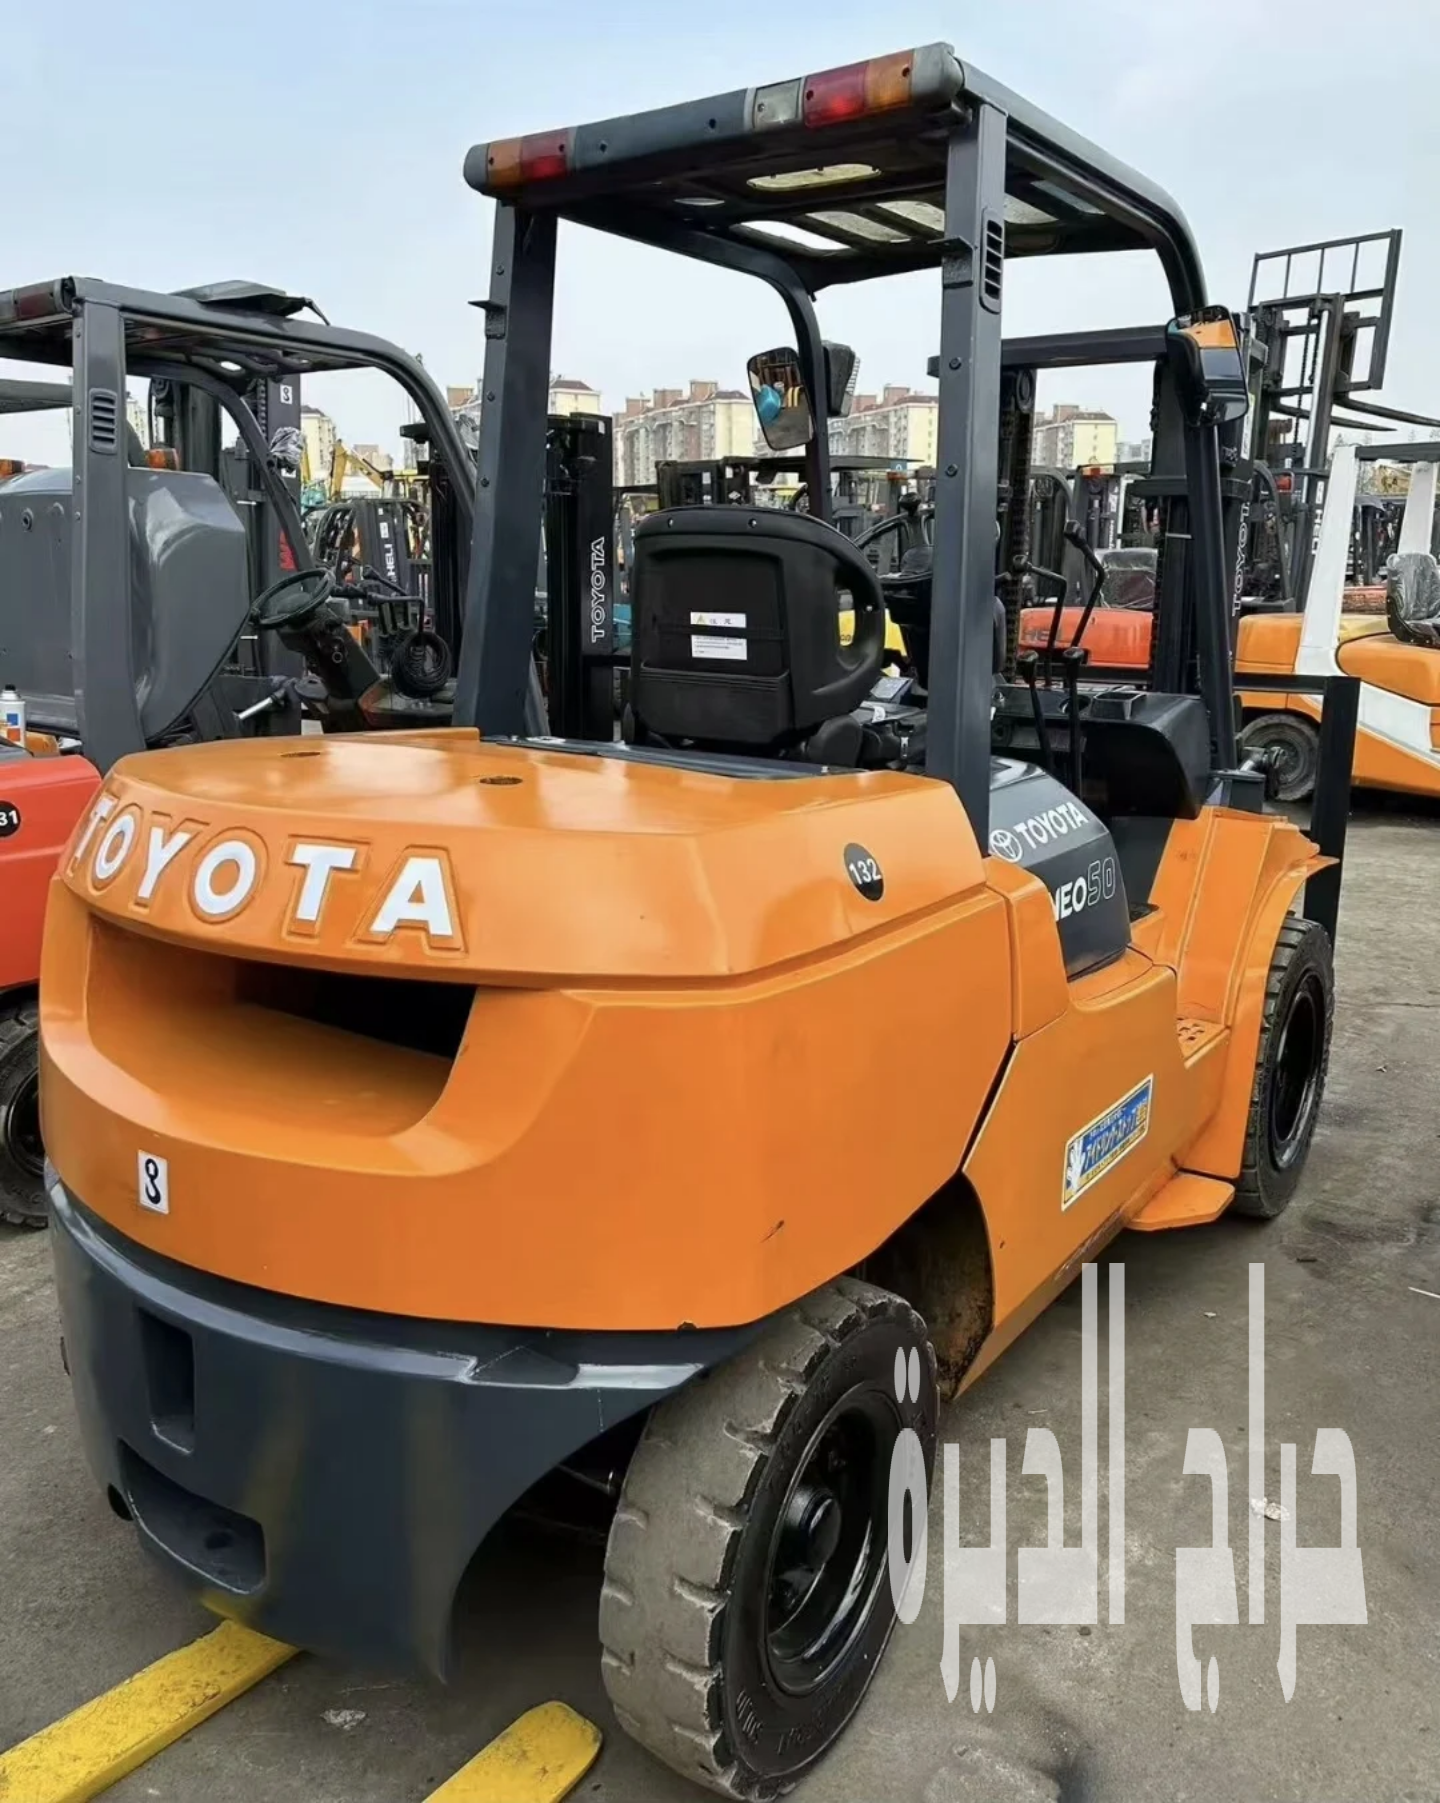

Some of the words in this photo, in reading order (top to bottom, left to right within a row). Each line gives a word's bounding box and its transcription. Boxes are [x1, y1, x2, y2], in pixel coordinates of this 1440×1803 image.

[384, 543, 397, 577] HELI
[591, 536, 606, 643] TOYOTA
[1232, 502, 1250, 617] TOYOT
[1013, 801, 1090, 850] TOYOTA
[75, 796, 454, 937] TOYOTA
[849, 858, 882, 885] 132
